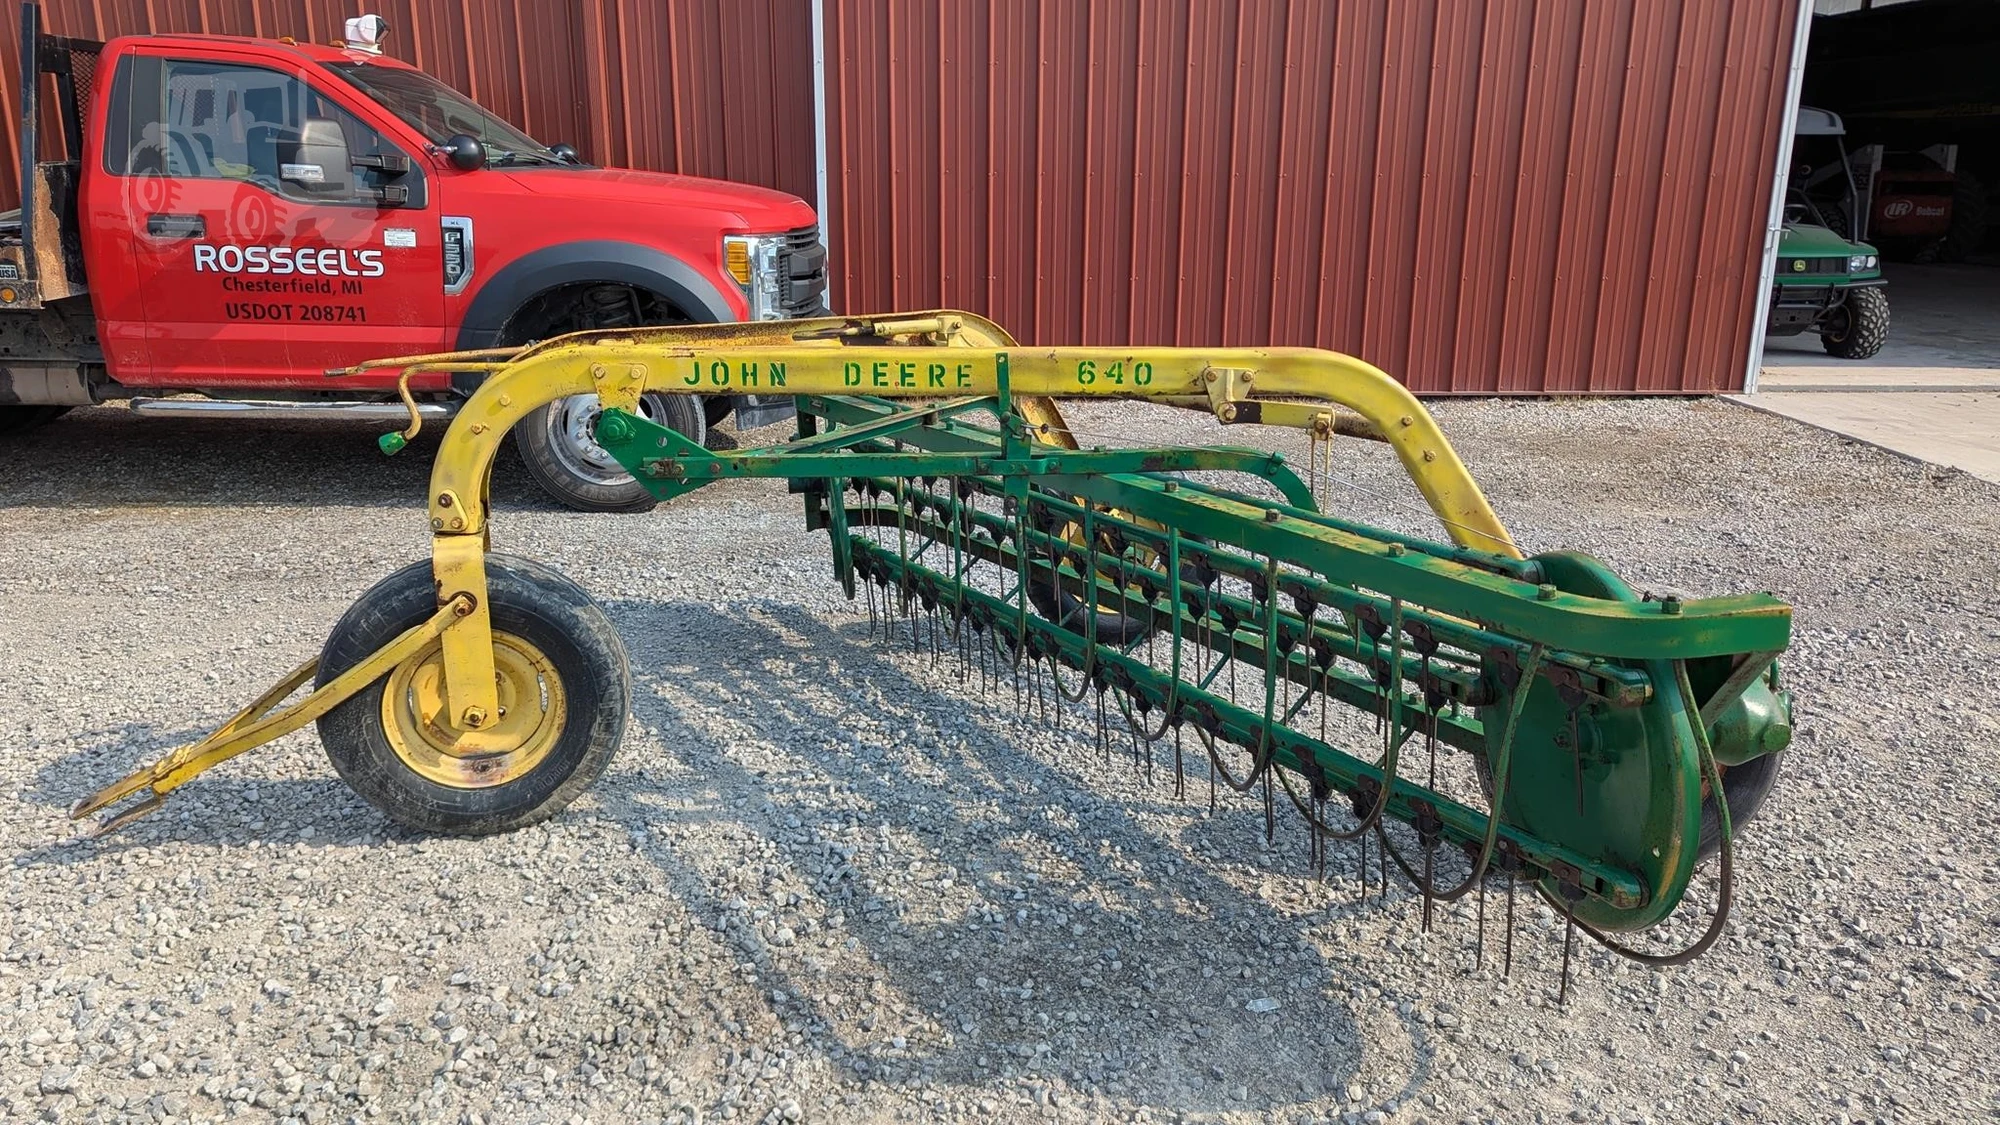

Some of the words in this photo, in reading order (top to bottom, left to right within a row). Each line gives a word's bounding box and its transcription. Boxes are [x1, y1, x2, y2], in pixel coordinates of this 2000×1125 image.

[193, 245, 385, 276] ROSSEEL'S
[444, 232, 461, 274] F550
[0, 269, 17, 278] USA
[222, 277, 337, 296] Chesterfield,
[341, 280, 363, 295] MI
[225, 303, 294, 321] USDOT
[300, 304, 366, 322] 208741
[684, 361, 786, 387] JOHN
[844, 362, 973, 387] DEERE
[1077, 360, 1152, 386] 640
